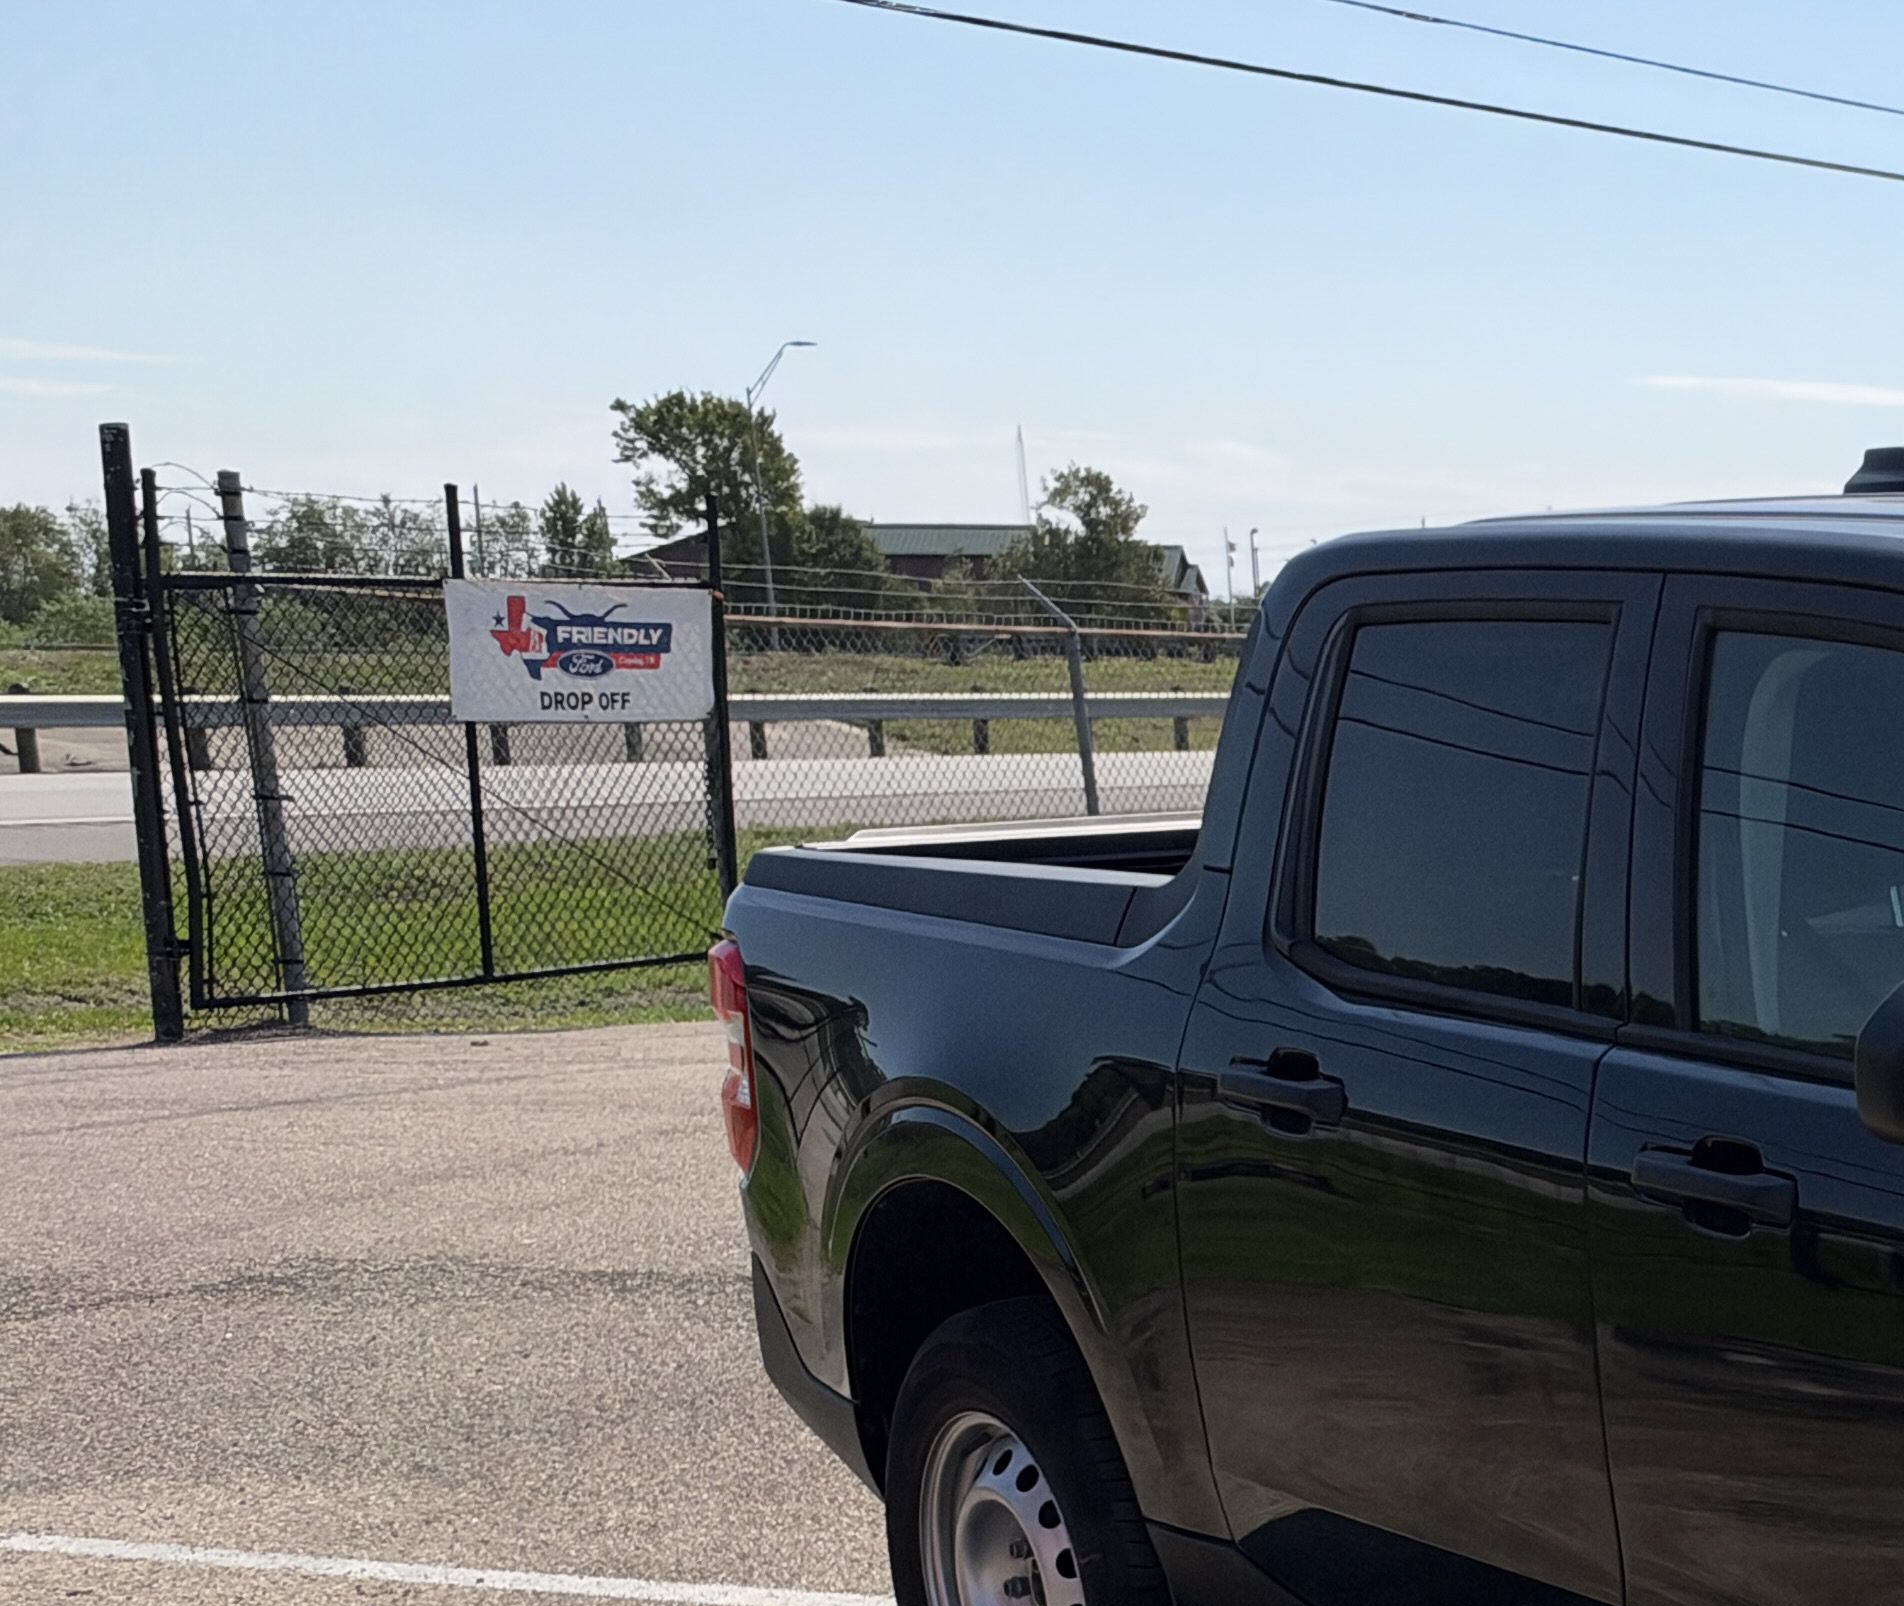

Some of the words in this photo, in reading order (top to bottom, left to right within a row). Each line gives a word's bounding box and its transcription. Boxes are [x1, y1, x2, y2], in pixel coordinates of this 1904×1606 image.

[557, 625, 663, 646] FRIENDLY
[569, 653, 604, 674] Ford
[540, 691, 593, 711] DROP
[598, 691, 631, 711] OFF
